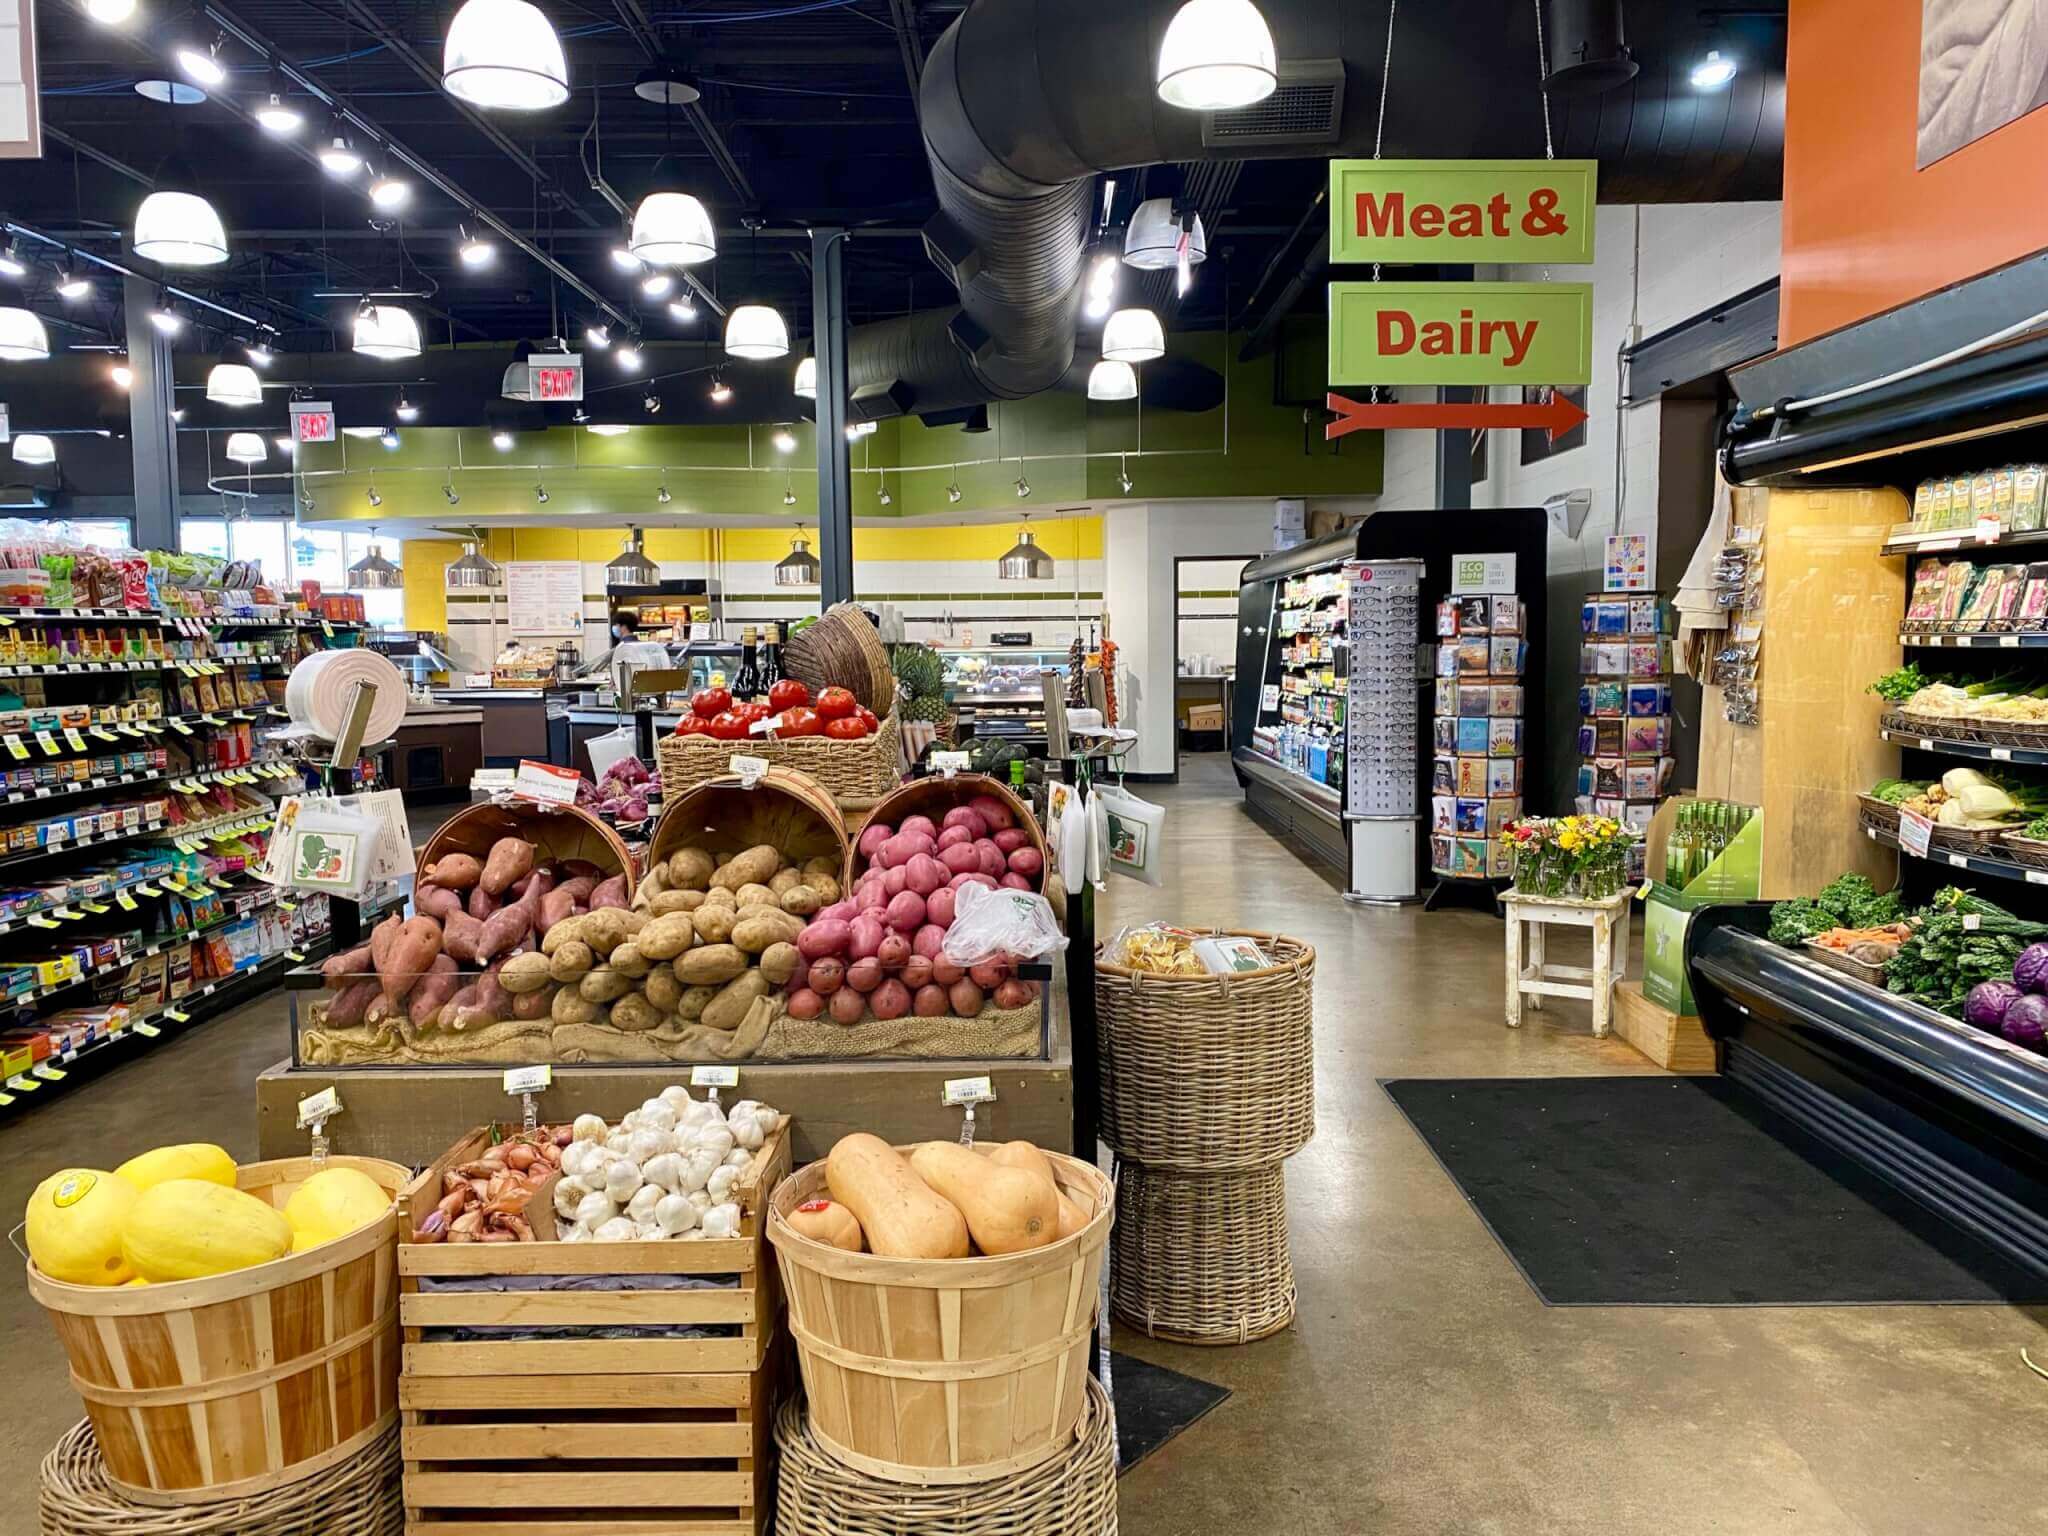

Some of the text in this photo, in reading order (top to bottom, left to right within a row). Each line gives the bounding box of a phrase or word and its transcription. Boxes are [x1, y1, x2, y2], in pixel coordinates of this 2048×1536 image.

[1355, 187, 1570, 238] Meat &
[1376, 309, 1540, 367] Dairy
[539, 368, 575, 399] EXIT
[299, 414, 328, 441] EXIT
[1461, 562, 1483, 572] ECO
